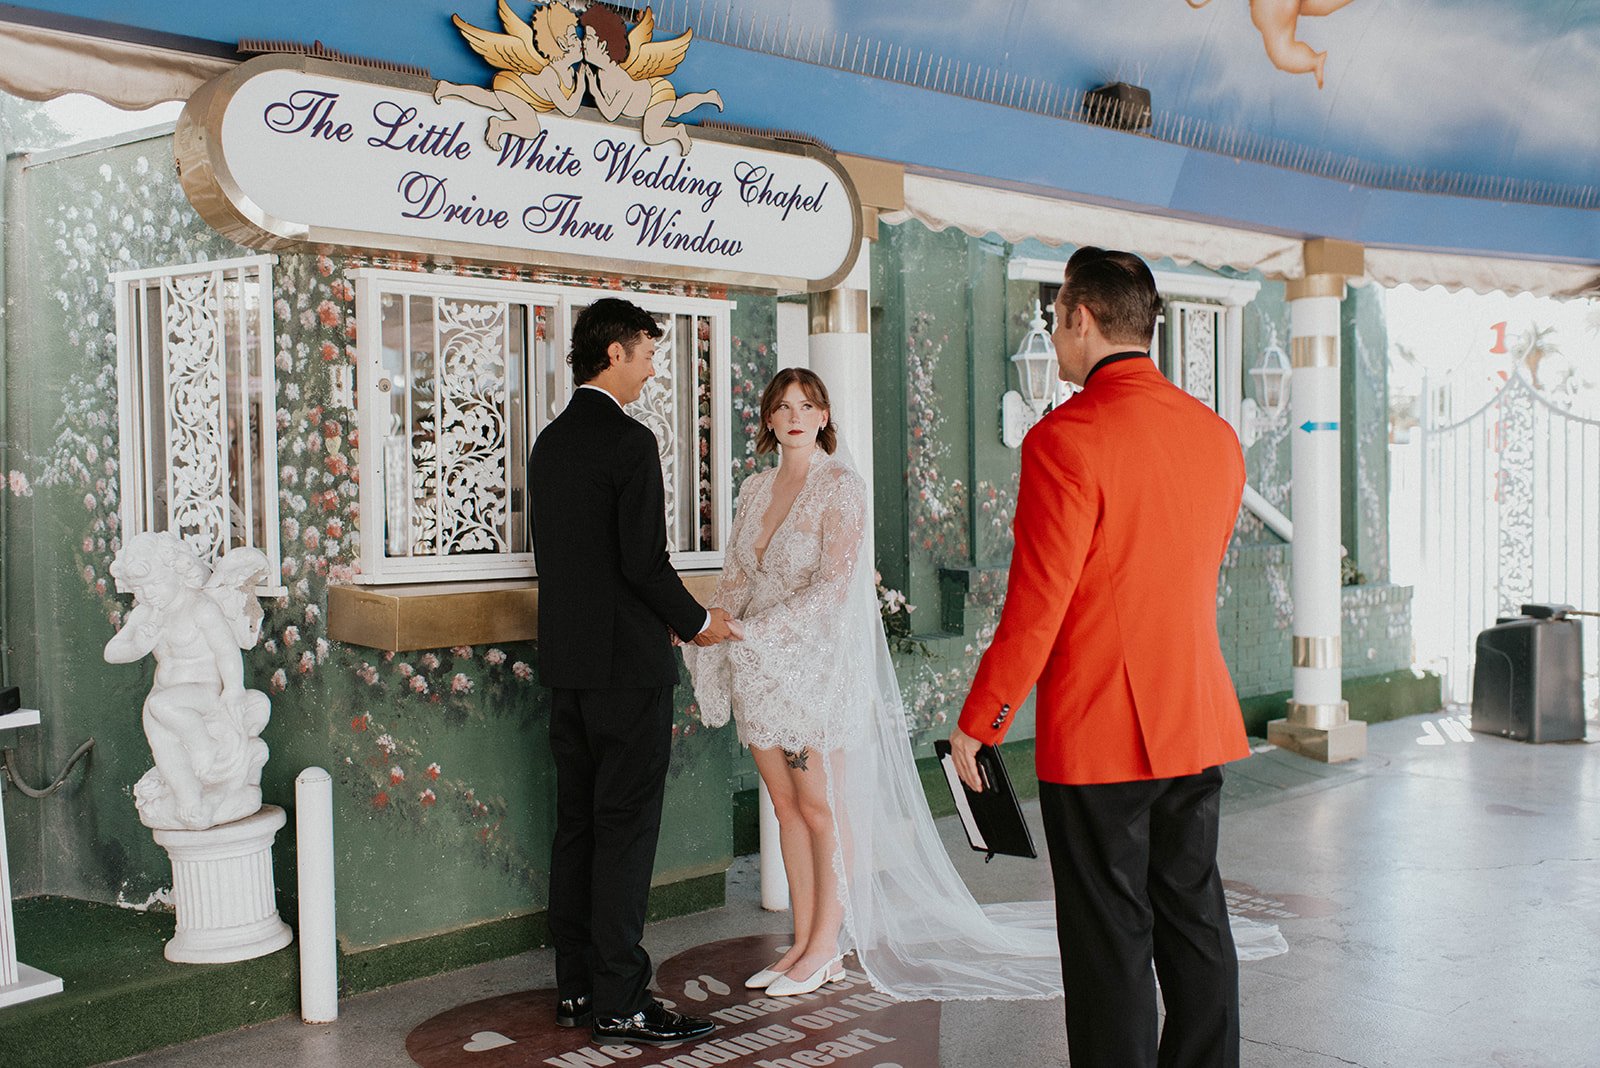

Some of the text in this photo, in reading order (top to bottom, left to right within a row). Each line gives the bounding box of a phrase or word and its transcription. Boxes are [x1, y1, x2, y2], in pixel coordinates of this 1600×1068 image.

[264, 90, 828, 221] The Little White Wedding Chapel
[397, 171, 744, 257] Drive Thru Window
[754, 1028, 897, 1068] heart
[791, 1006, 861, 1030] on
